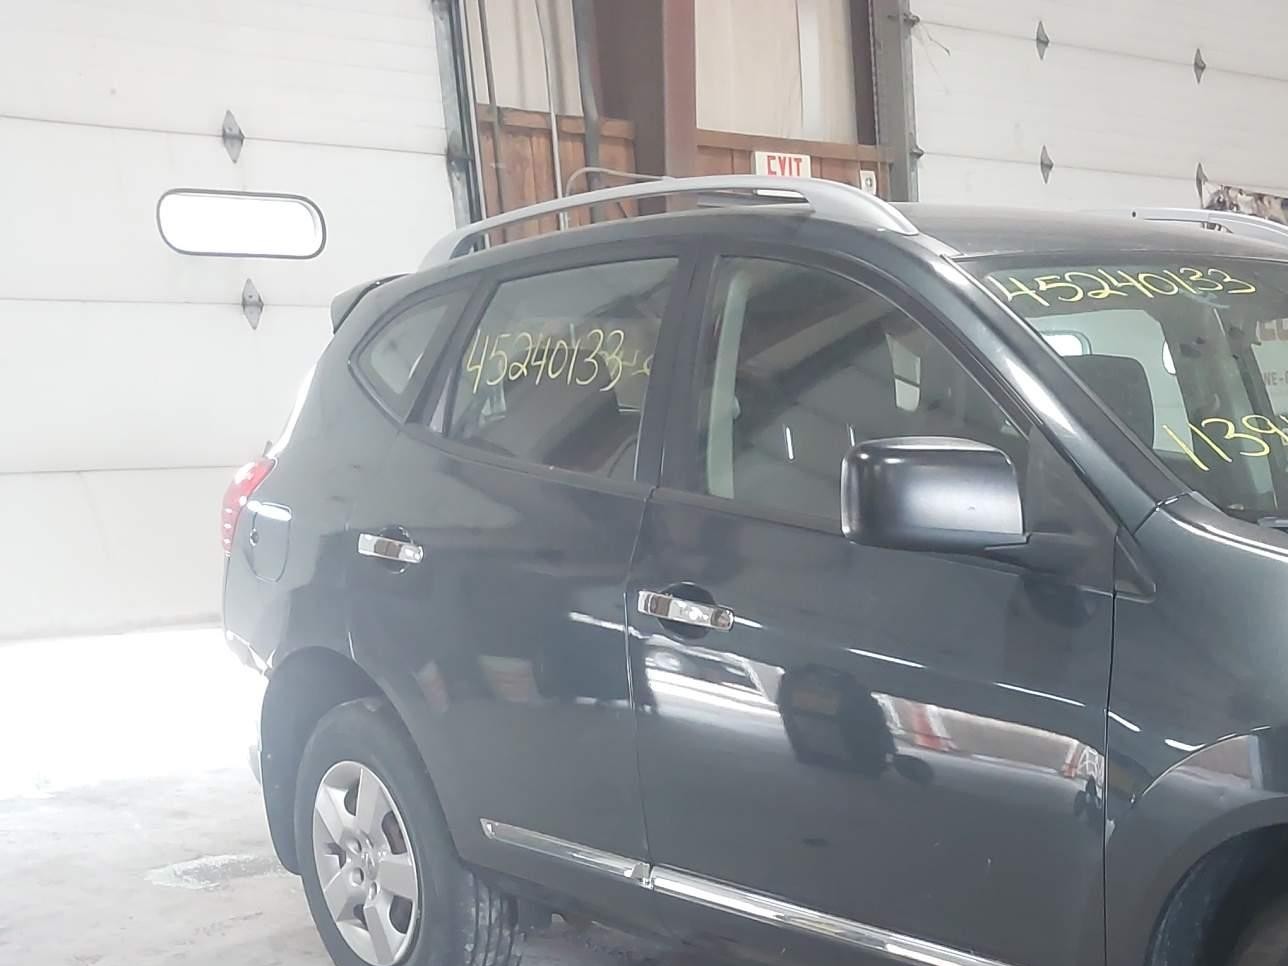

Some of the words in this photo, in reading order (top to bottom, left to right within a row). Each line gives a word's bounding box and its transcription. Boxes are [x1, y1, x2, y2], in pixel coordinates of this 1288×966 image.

[766, 155, 802, 177] EXIT
[986, 267, 1257, 307] 45240133
[466, 328, 625, 395] 45240133
